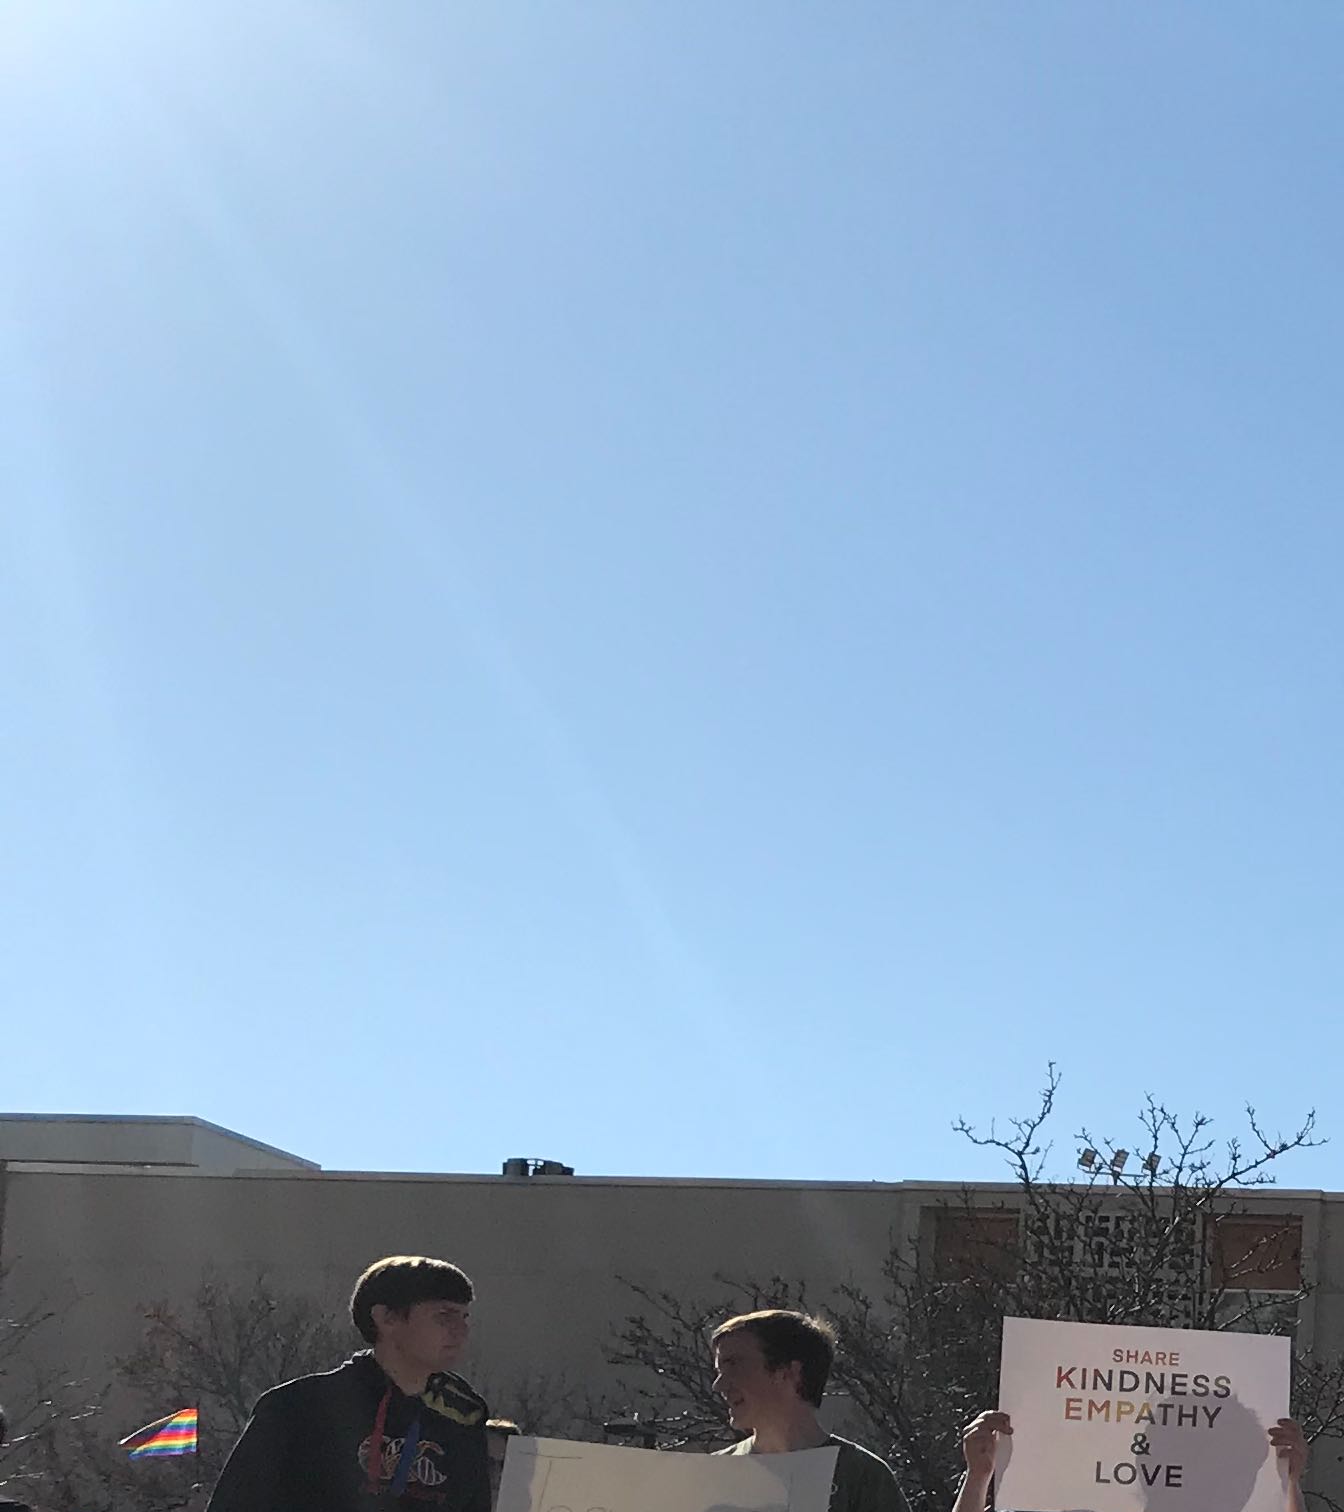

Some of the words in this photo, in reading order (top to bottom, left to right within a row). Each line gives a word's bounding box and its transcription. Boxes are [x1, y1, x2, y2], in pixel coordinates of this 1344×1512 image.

[1112, 1348, 1180, 1367] SHARE
[1056, 1366, 1232, 1399] KINDNESS
[1064, 1397, 1223, 1429] EMPATHY
[1130, 1432, 1151, 1456] &
[1095, 1461, 1184, 1488] LOVE
